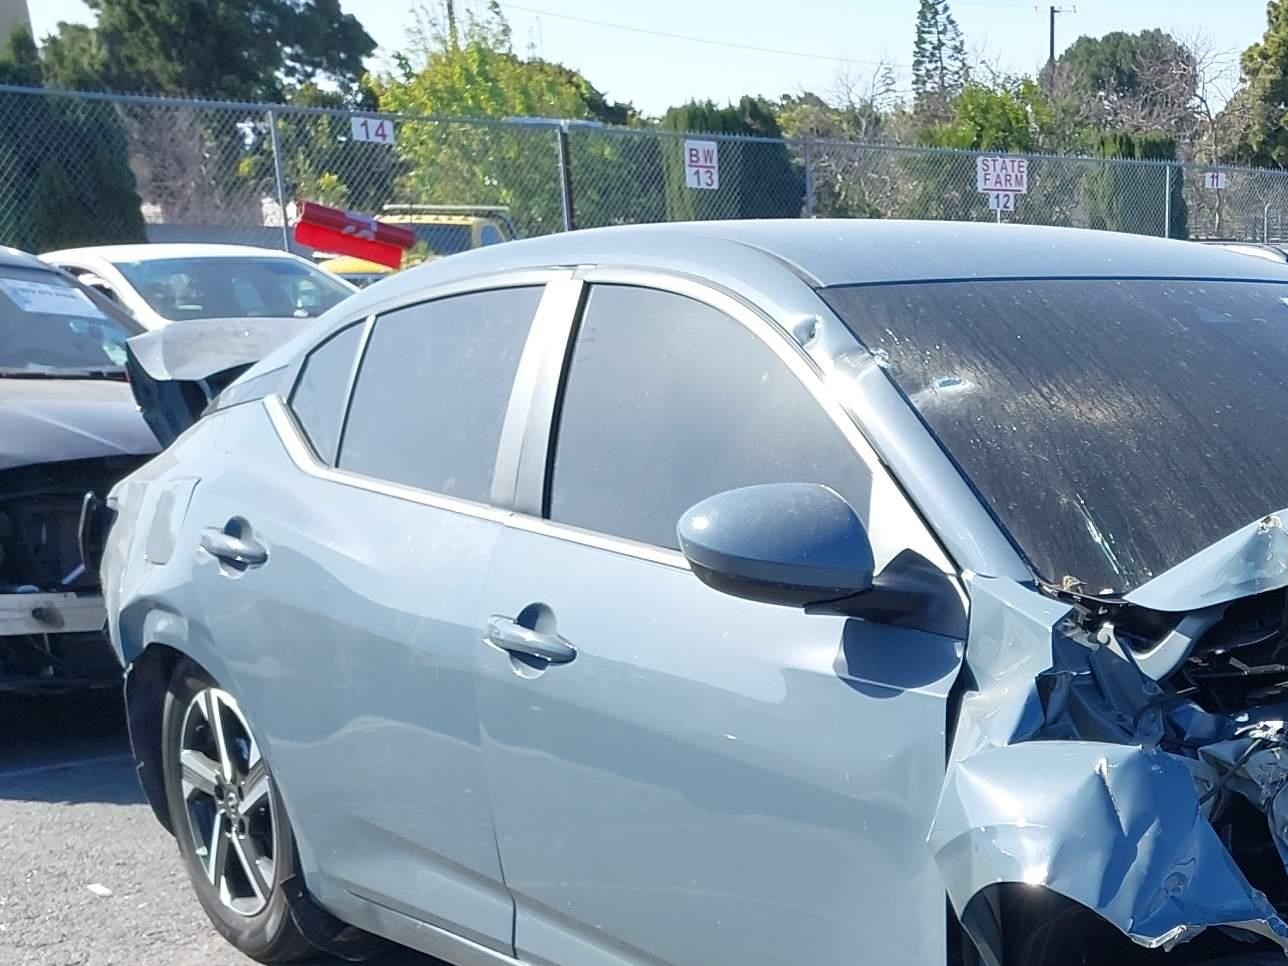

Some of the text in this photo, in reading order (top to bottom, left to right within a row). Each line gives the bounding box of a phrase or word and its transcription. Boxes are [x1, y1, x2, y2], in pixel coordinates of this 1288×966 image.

[360, 119, 388, 142] 14
[981, 158, 1026, 174] STATE
[692, 169, 715, 187] 13
[983, 173, 1025, 187] FARM
[1210, 174, 1220, 188] 11
[994, 194, 1011, 209] 12
